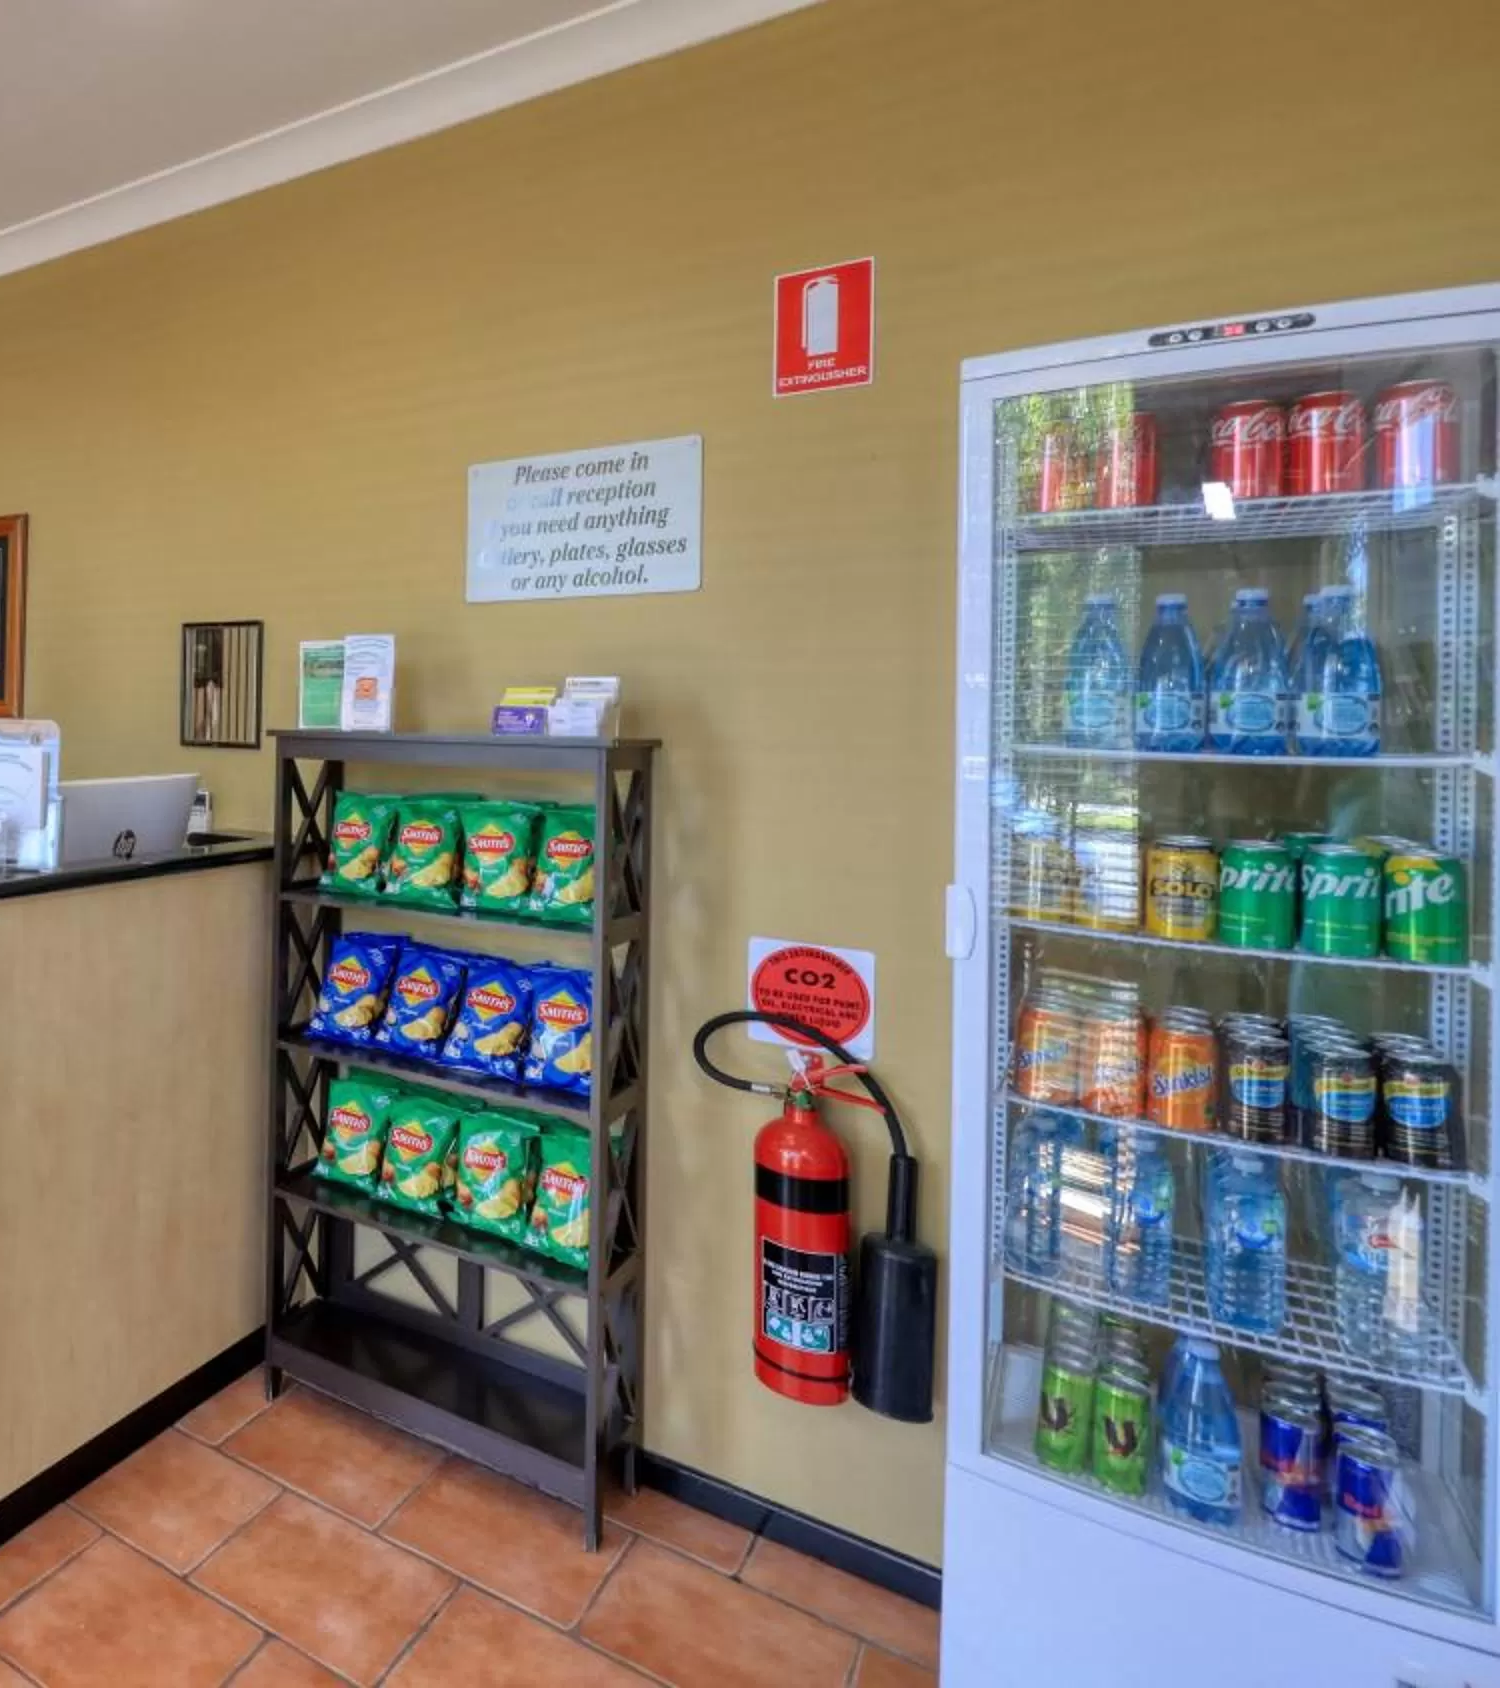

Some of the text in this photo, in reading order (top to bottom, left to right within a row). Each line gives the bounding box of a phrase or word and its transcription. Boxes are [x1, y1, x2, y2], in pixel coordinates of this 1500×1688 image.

[807, 357, 836, 370] FIRE
[514, 451, 649, 486] Please come in
[566, 480, 656, 507] reception
[500, 521, 531, 542] you
[536, 512, 580, 536] need
[584, 504, 671, 532] anything
[550, 542, 611, 567] plates,
[615, 535, 688, 562] glasses
[511, 564, 649, 593] or any alcohol.
[1151, 879, 1213, 899] SOLO
[784, 968, 836, 989] CO2
